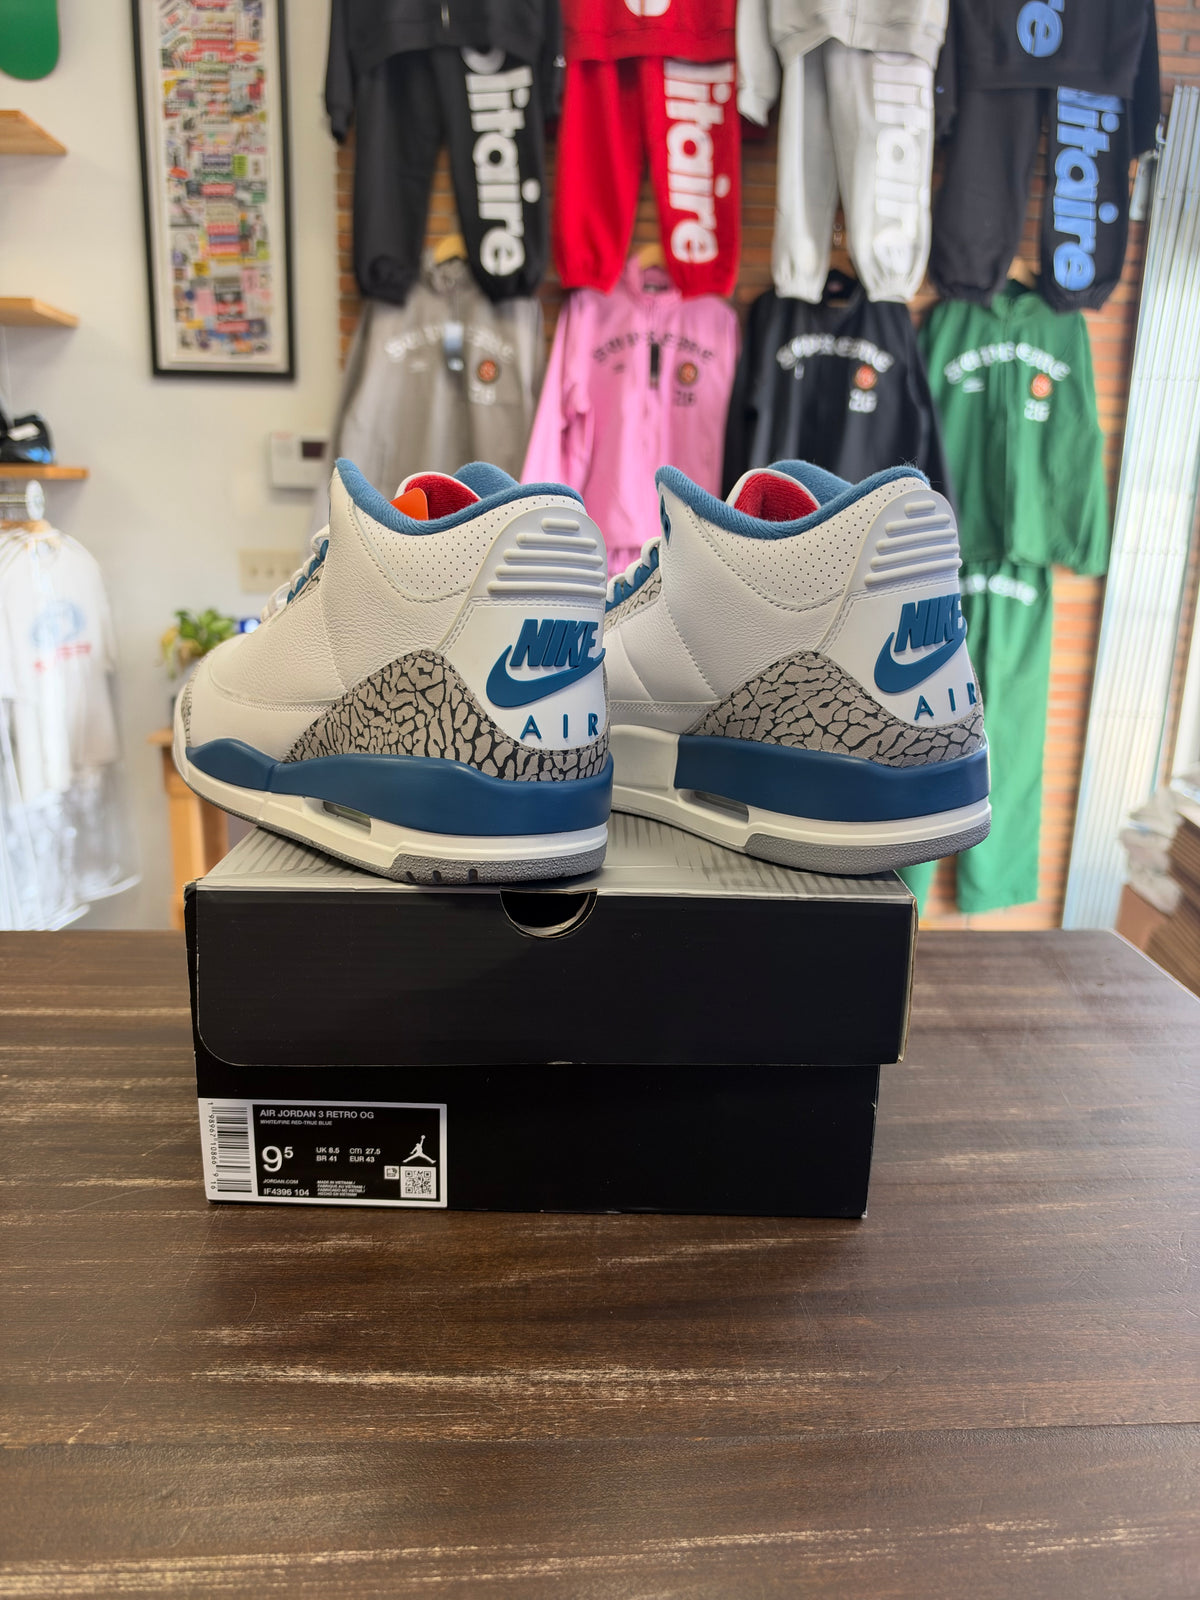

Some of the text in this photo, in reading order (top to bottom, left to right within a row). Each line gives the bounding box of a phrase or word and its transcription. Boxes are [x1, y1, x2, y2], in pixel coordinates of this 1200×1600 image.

[1017, 0, 1064, 57] e
[894, 593, 962, 653] NIKE
[509, 619, 599, 668] NIKE
[914, 682, 977, 721] AIR
[520, 713, 599, 740] AIR
[208, 1114, 217, 1138] 98967
[260, 1109, 375, 1119] AIR JORDAN 3 RETRO OG
[349, 1155, 364, 1163] EUR
[263, 1187, 310, 1196] IF4396 104
